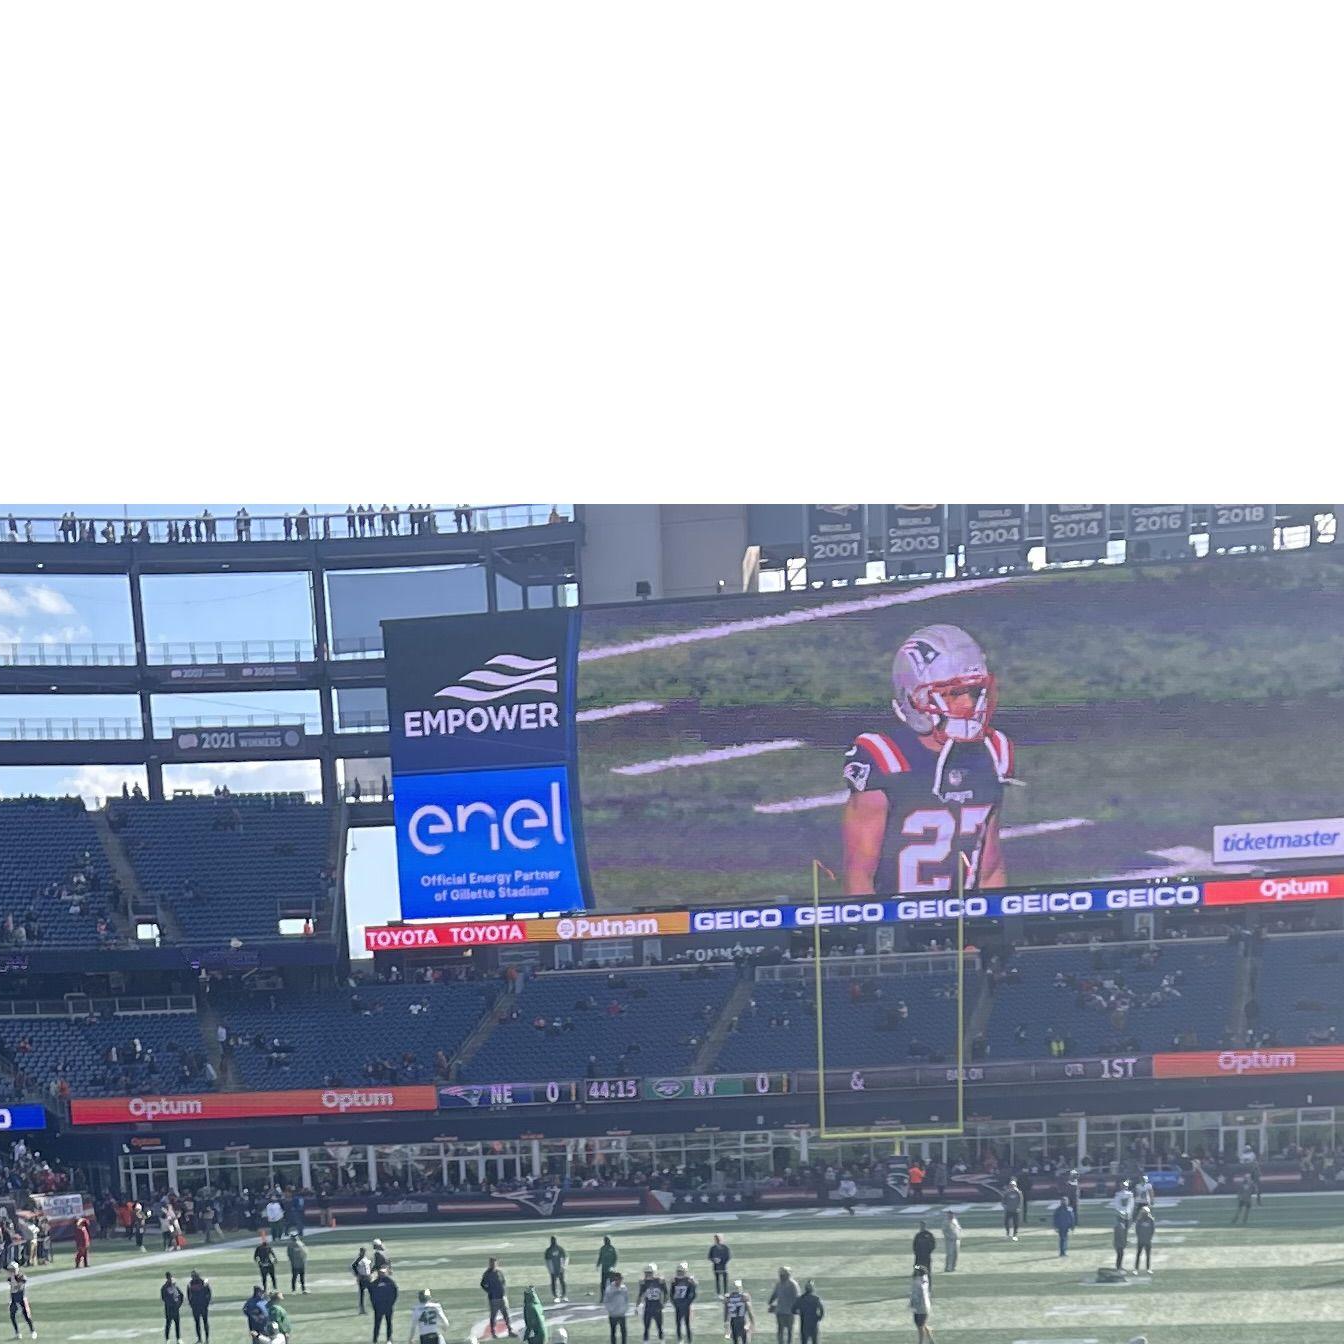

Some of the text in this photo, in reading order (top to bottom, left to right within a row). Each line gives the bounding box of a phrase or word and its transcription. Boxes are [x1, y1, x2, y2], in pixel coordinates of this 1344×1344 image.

[1135, 513, 1182, 531] 2016
[1217, 505, 1265, 524] 2018
[970, 527, 1020, 545] 2004
[1053, 520, 1099, 539] 2014
[813, 541, 859, 559] 2001
[890, 535, 940, 553] 2003
[404, 702, 559, 737] EMPOWER
[201, 731, 236, 749] 2021
[238, 737, 283, 748] WINNERS
[408, 781, 566, 855] enel
[1222, 829, 1342, 852] ticketmaster
[420, 869, 562, 887] Official Energy Partner
[1259, 878, 1329, 899] Optum
[434, 885, 549, 902] of Gillette Stadium
[694, 885, 1200, 931] GEICO GEICO GEICO GEICO GEICO
[366, 924, 524, 948] TOYOTA TOYOTA
[575, 918, 659, 939] Putnam
[1100, 1058, 1138, 1080] 1ST
[1217, 1049, 1297, 1073] Optum
[545, 1081, 560, 1103] 0
[588, 1079, 638, 1100] 44:15
[756, 1072, 769, 1094] 0
[321, 1089, 394, 1112] Optum
[490, 1084, 513, 1105] NE
[128, 1097, 203, 1121] Optum
[419, 1310, 437, 1326] 42
